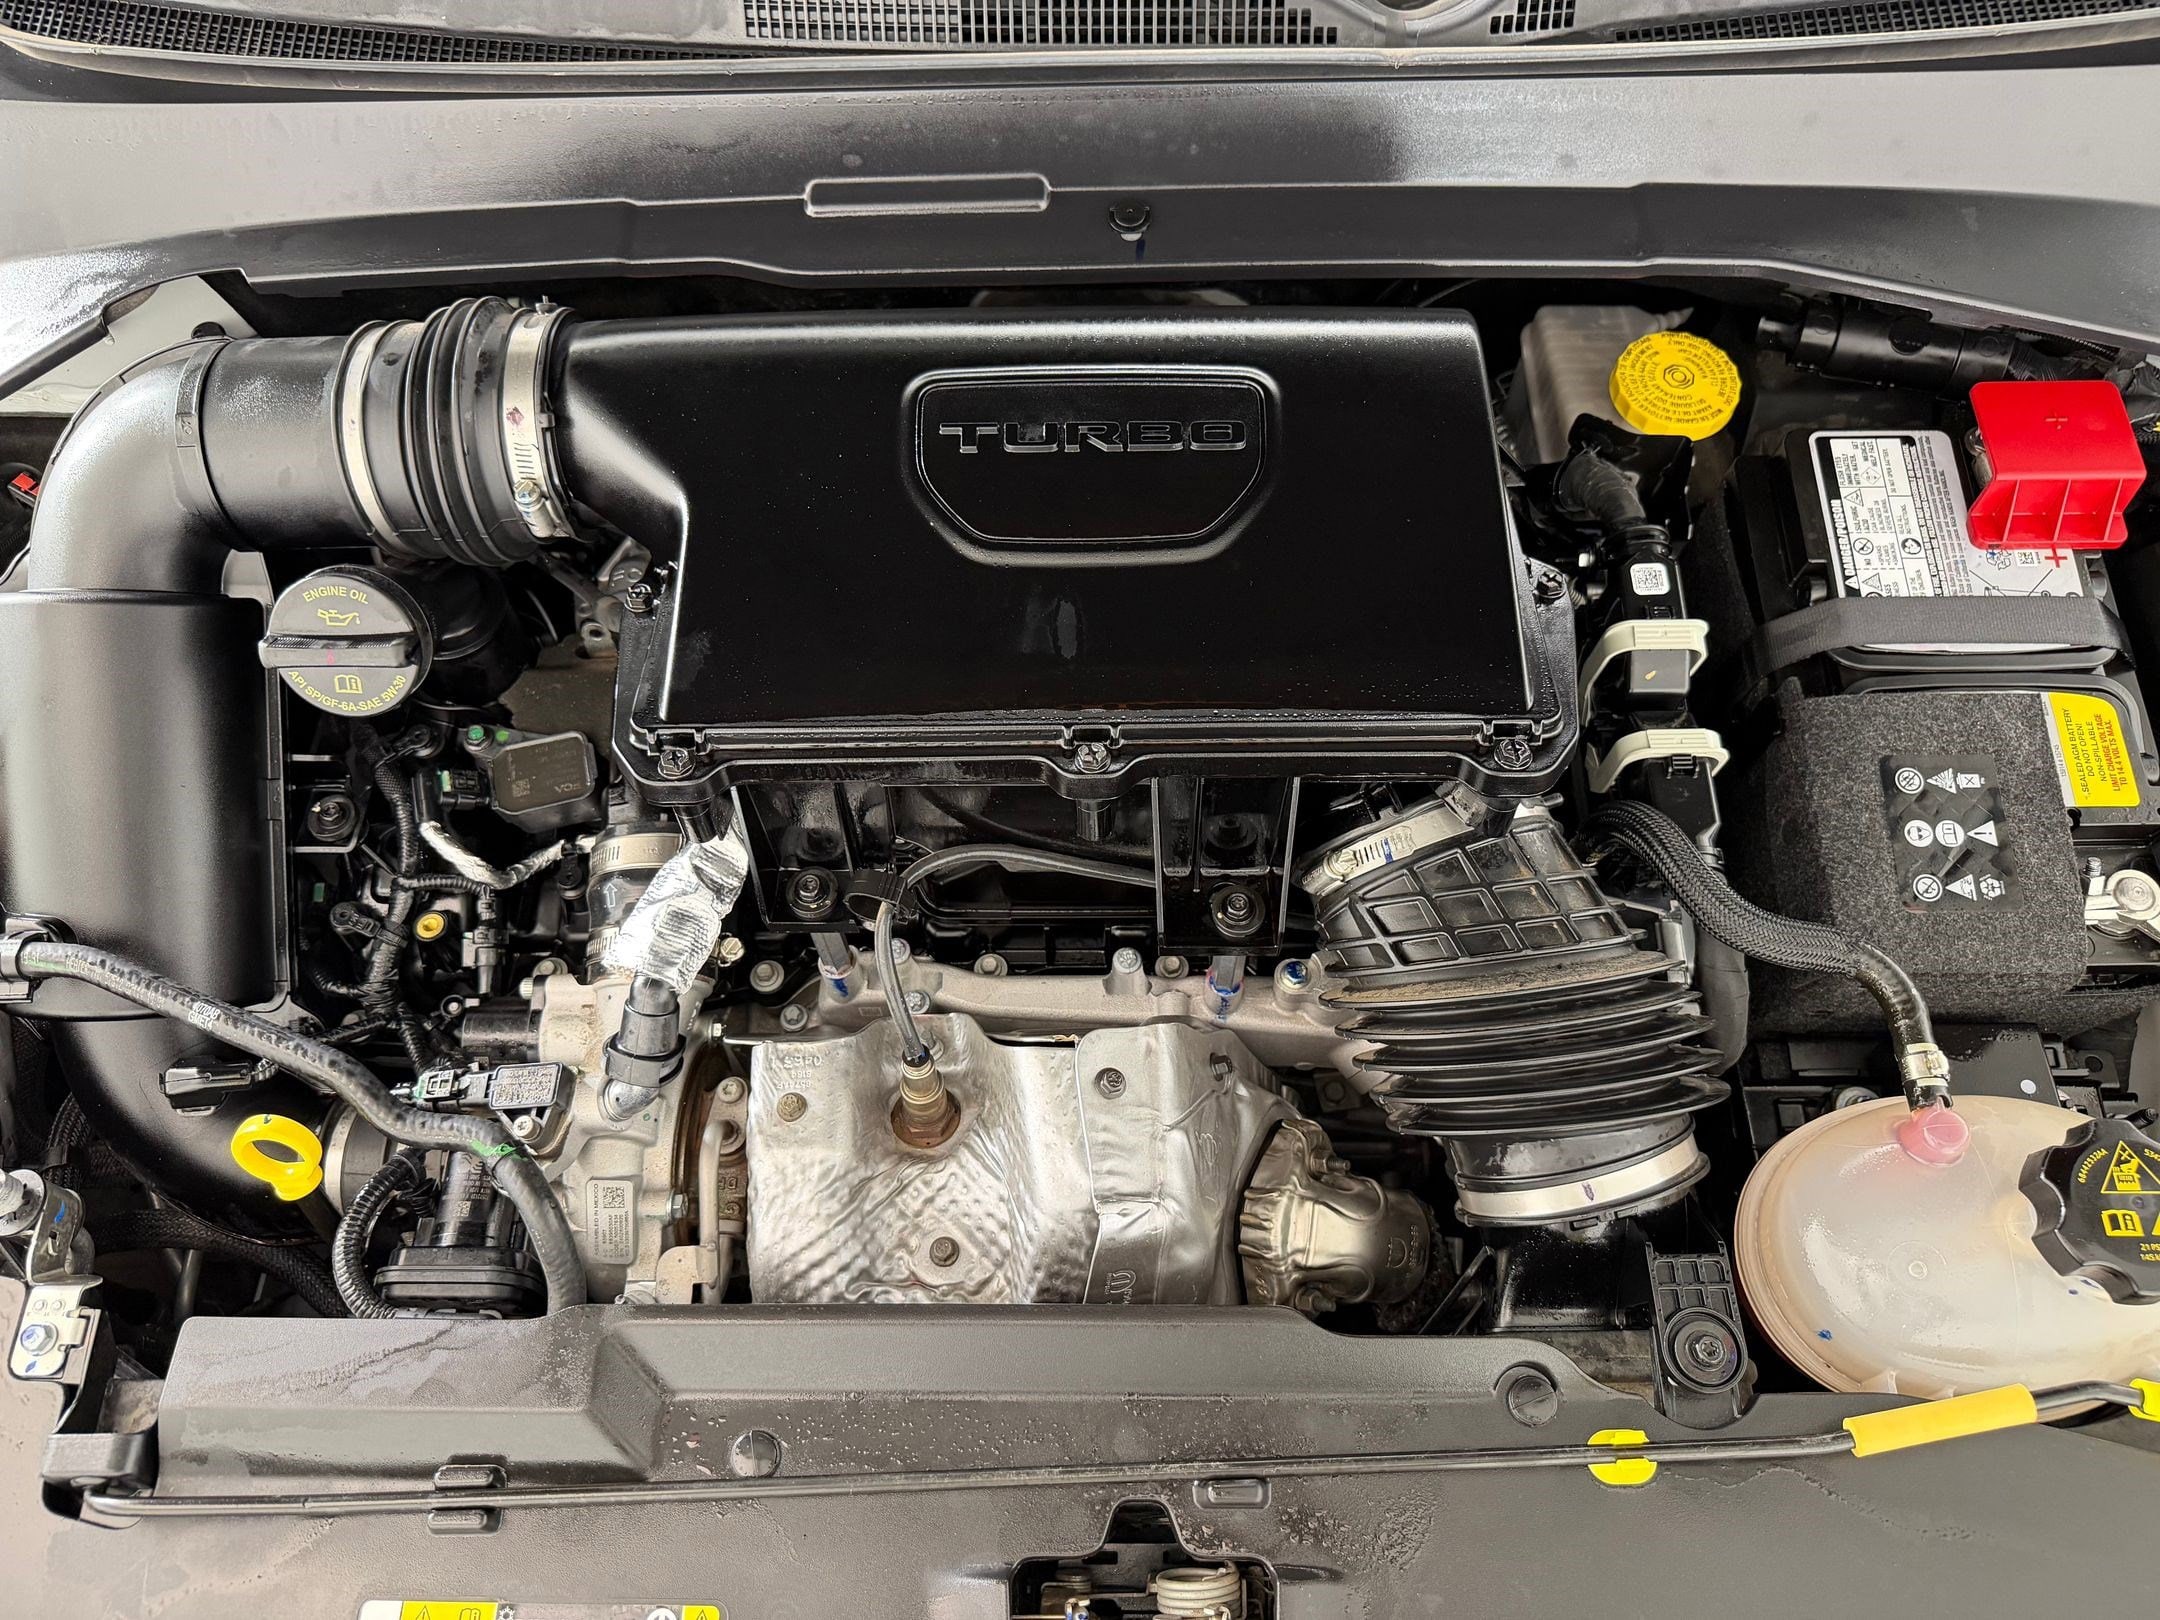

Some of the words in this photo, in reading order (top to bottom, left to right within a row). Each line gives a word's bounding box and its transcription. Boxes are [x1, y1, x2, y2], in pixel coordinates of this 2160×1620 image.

[939, 421, 1247, 453] TURBO
[1830, 499, 1856, 576] DANGER/POISON
[303, 586, 347, 602] ENGINE
[350, 588, 369, 604] OIL
[289, 671, 306, 688] API
[305, 685, 383, 712] SP/GF-6A-SAE
[385, 675, 407, 702] 5W-30
[2062, 708, 2077, 742] BATTERY
[2075, 723, 2087, 746] OPEN!
[2094, 713, 2108, 742] VOLTAGE
[2072, 743, 2081, 760] AGM
[2082, 749, 2091, 763] NOT
[2086, 720, 2107, 781] NON-SPILLABLE
[2102, 744, 2115, 771] CHARGE
[2108, 738, 2120, 758] VOLTS
[2086, 765, 2095, 776] DO
[2114, 760, 2124, 774] 14.4
[2110, 773, 2120, 791] LIMIT
[2118, 777, 2127, 785] TO
